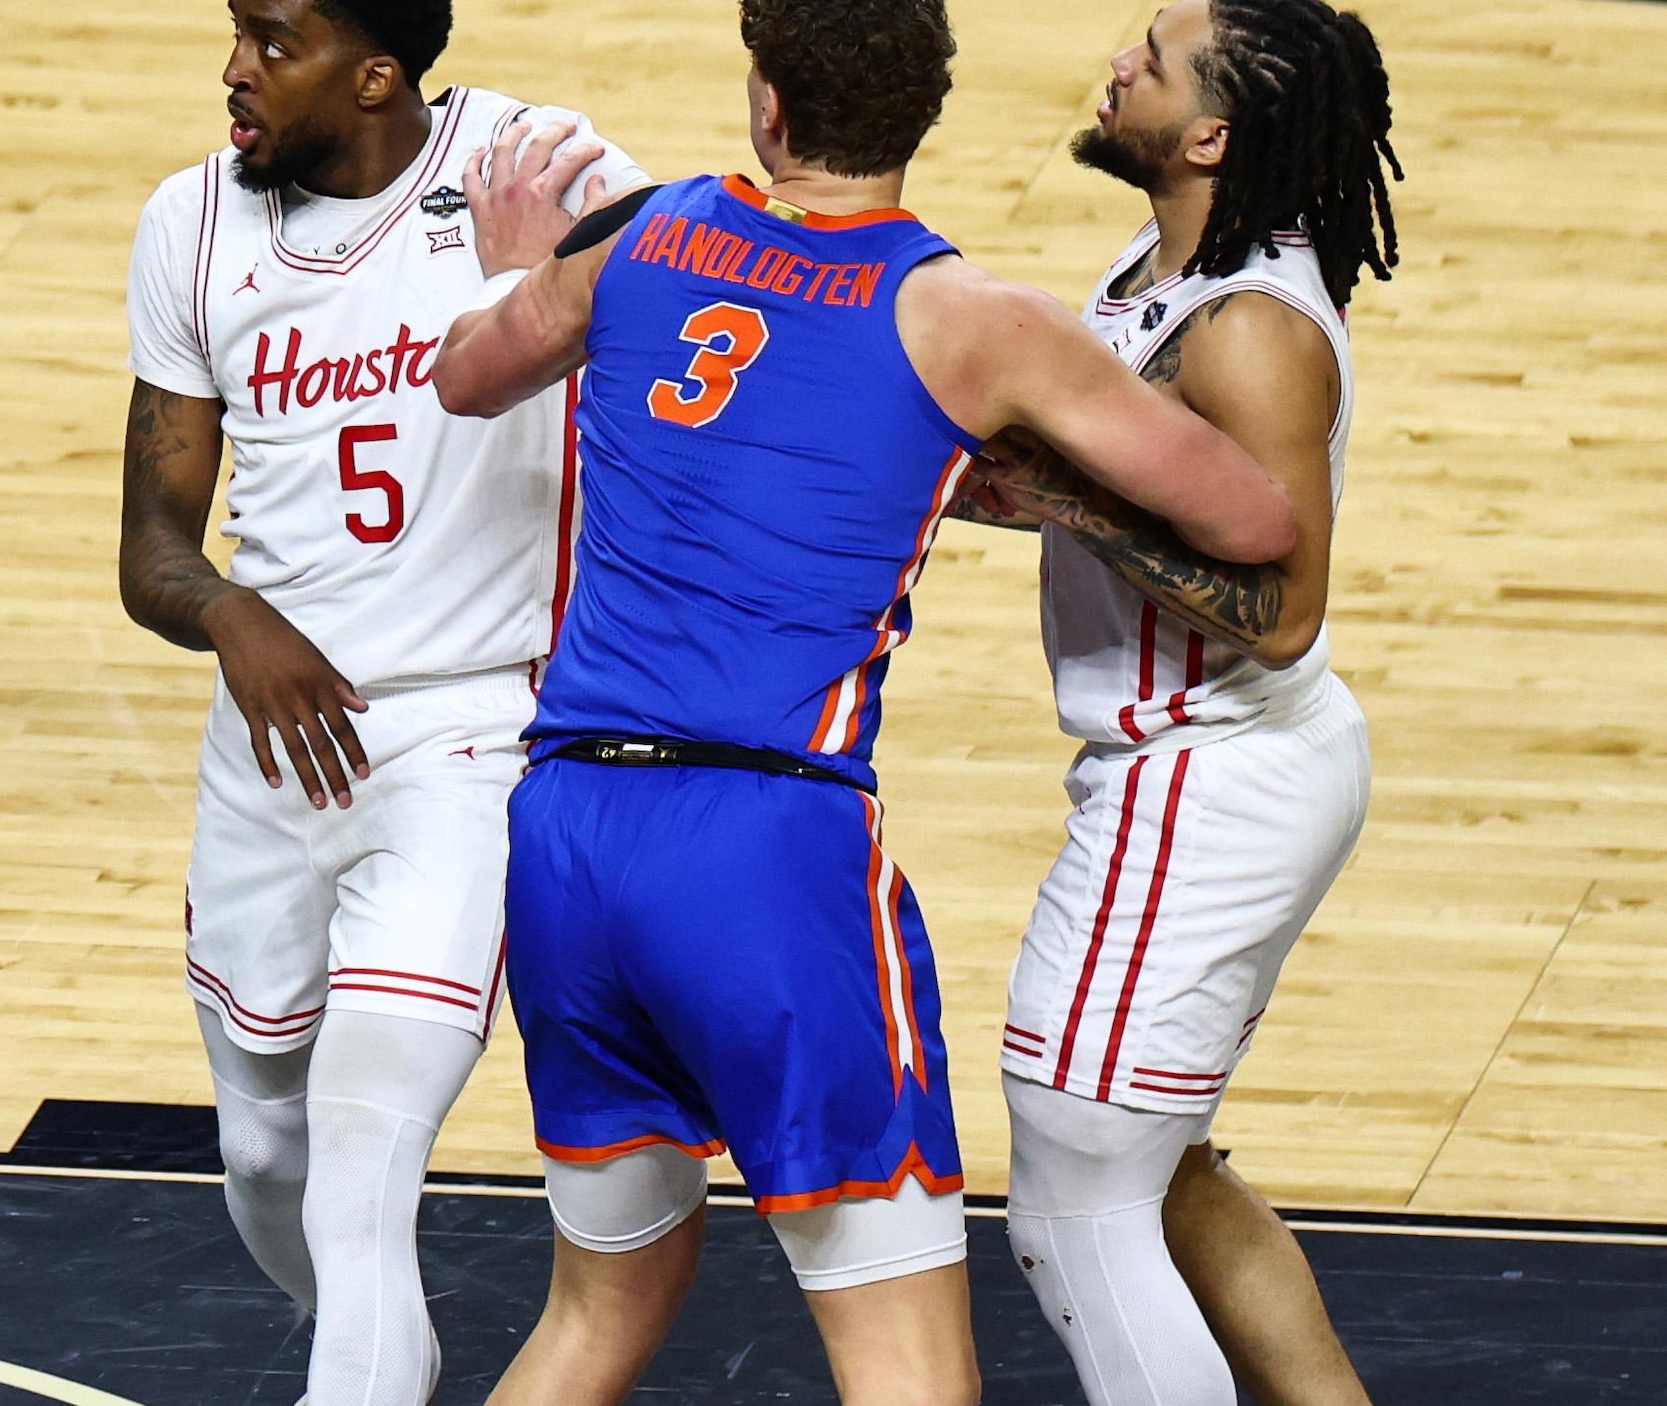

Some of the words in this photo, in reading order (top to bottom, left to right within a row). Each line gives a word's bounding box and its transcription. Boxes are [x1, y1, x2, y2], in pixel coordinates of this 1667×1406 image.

[423, 196, 445, 208] FINAL
[629, 212, 886, 308] HANDLOGTEN
[247, 323, 441, 418] Housto
[646, 301, 770, 429] 3
[338, 423, 404, 544] 5
